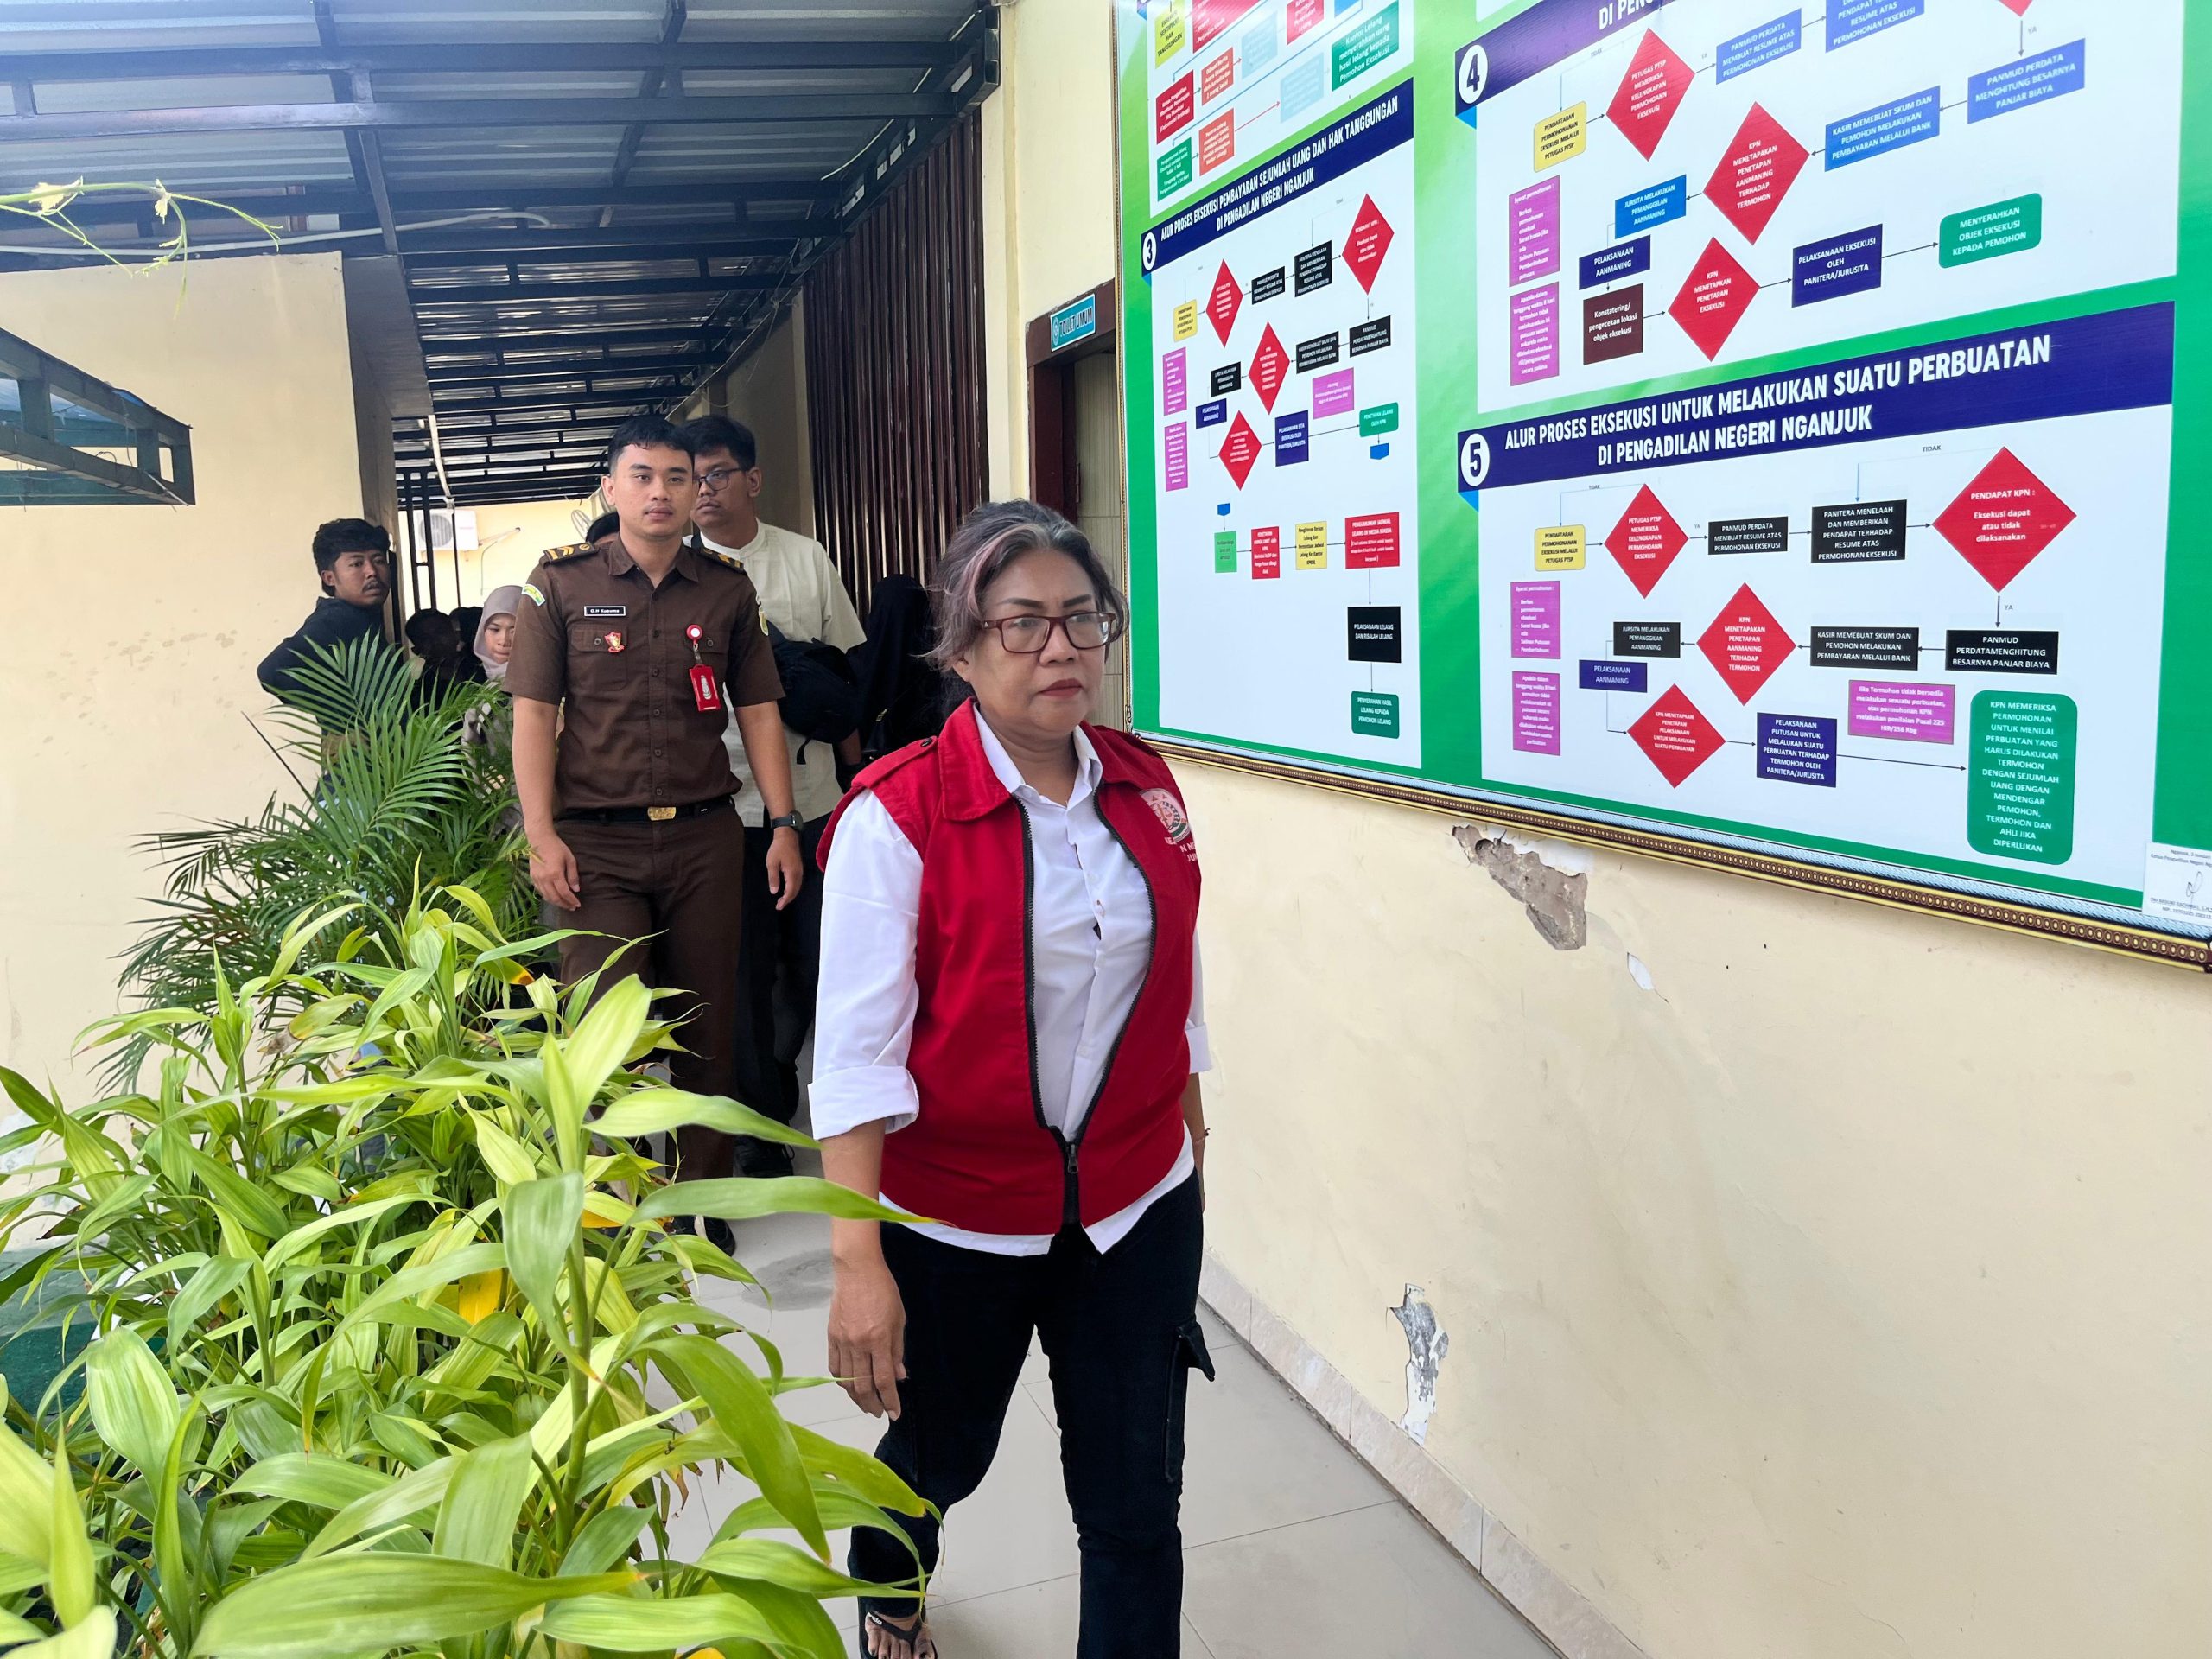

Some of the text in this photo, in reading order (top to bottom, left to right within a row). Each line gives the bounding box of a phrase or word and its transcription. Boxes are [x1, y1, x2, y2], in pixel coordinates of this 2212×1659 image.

[1599, 3, 1613, 30] DI
[1466, 54, 1480, 92] 4
[1987, 54, 2063, 84] PANMUD PERDATA
[1975, 63, 2075, 101] MENGHITUNG BESARNYA
[1996, 84, 2052, 107] PANJAR BIAYA
[1833, 122, 1851, 135] KASIR
[1893, 101, 1914, 115] SKUM
[1916, 95, 1931, 107] DAN
[1841, 112, 1921, 143] PEMOHON MELAKUKAN
[1749, 139, 1760, 149] KPN
[1832, 121, 1930, 158] PEMBAYARAN MELALUI BANK
[1161, 95, 1398, 241] ALUR PROSES EKSEKUSI PEMBAYARAN SEJUMLAH UANG DAN HAK TANGGUNGAN
[1737, 157, 1771, 175] PENETAPAN
[1735, 168, 1773, 187] AANMANING
[1738, 181, 1769, 197] TERHADAP
[1217, 166, 1314, 232] DI PENGADILAN NEGERI NGANJUK
[1737, 192, 1770, 209] TERMOHON
[1960, 207, 2019, 227] MENYERAHKAN
[1959, 220, 2020, 240] OBJEK EKSEKUSI
[1798, 238, 1875, 263] PELAKSANAAN EKSEKUSI
[1952, 232, 2026, 254] KEPADA PEMOHON
[1593, 246, 1633, 264] PELAKSANAAN
[1827, 257, 1844, 267] OLEH
[1595, 259, 1631, 276] AANMANING
[1803, 264, 1868, 284] PANITERA/JURUSITA
[1075, 306, 1092, 329] UMUM
[1594, 303, 1630, 318] Konstatering/
[1588, 314, 1637, 331] pengecekan lokasi
[1593, 327, 1631, 341] objek eksekusi
[1505, 335, 2050, 449] ALUR PROSES EKSEKUSI UNTUK MELAKUKAN SUATU PERBUATAN
[1598, 405, 1872, 466] DI PENGADILAN NEGERI NGANJUK
[1922, 444, 1942, 453] TIDAK
[1470, 442, 1481, 477] 5
[1970, 490, 2012, 499] PENDAPAT
[1856, 506, 1892, 515] MENELAAH
[2007, 510, 2030, 518] dapat
[1843, 518, 1888, 526] MEMBERIKAN
[1775, 719, 1816, 728] PELAKSANAAN
[1993, 713, 2051, 721] PERMOHONAN
[2019, 726, 2053, 734] MENILAI
[1986, 735, 2032, 745] PERBUATAN
[1763, 747, 1828, 760] PERBUATAN TERHADAP
[2012, 749, 2058, 759] DILAKUKAN
[1770, 757, 1803, 767] TERMOHON
[1998, 759, 2044, 769] TERMOHON
[1766, 766, 1824, 779] PANITERA/JURUSITA
[1982, 769, 2058, 782] DENGAN SEJUMLAH
[1990, 781, 2049, 793] UANG DENGAN
[1993, 793, 2044, 804] MENDENGAR
[1997, 805, 2041, 817] PEMOHON,
[1986, 815, 2031, 827] TERMOHON
[1999, 828, 2018, 836] AHLI
[1993, 839, 2042, 851] DIPERLUKAN
